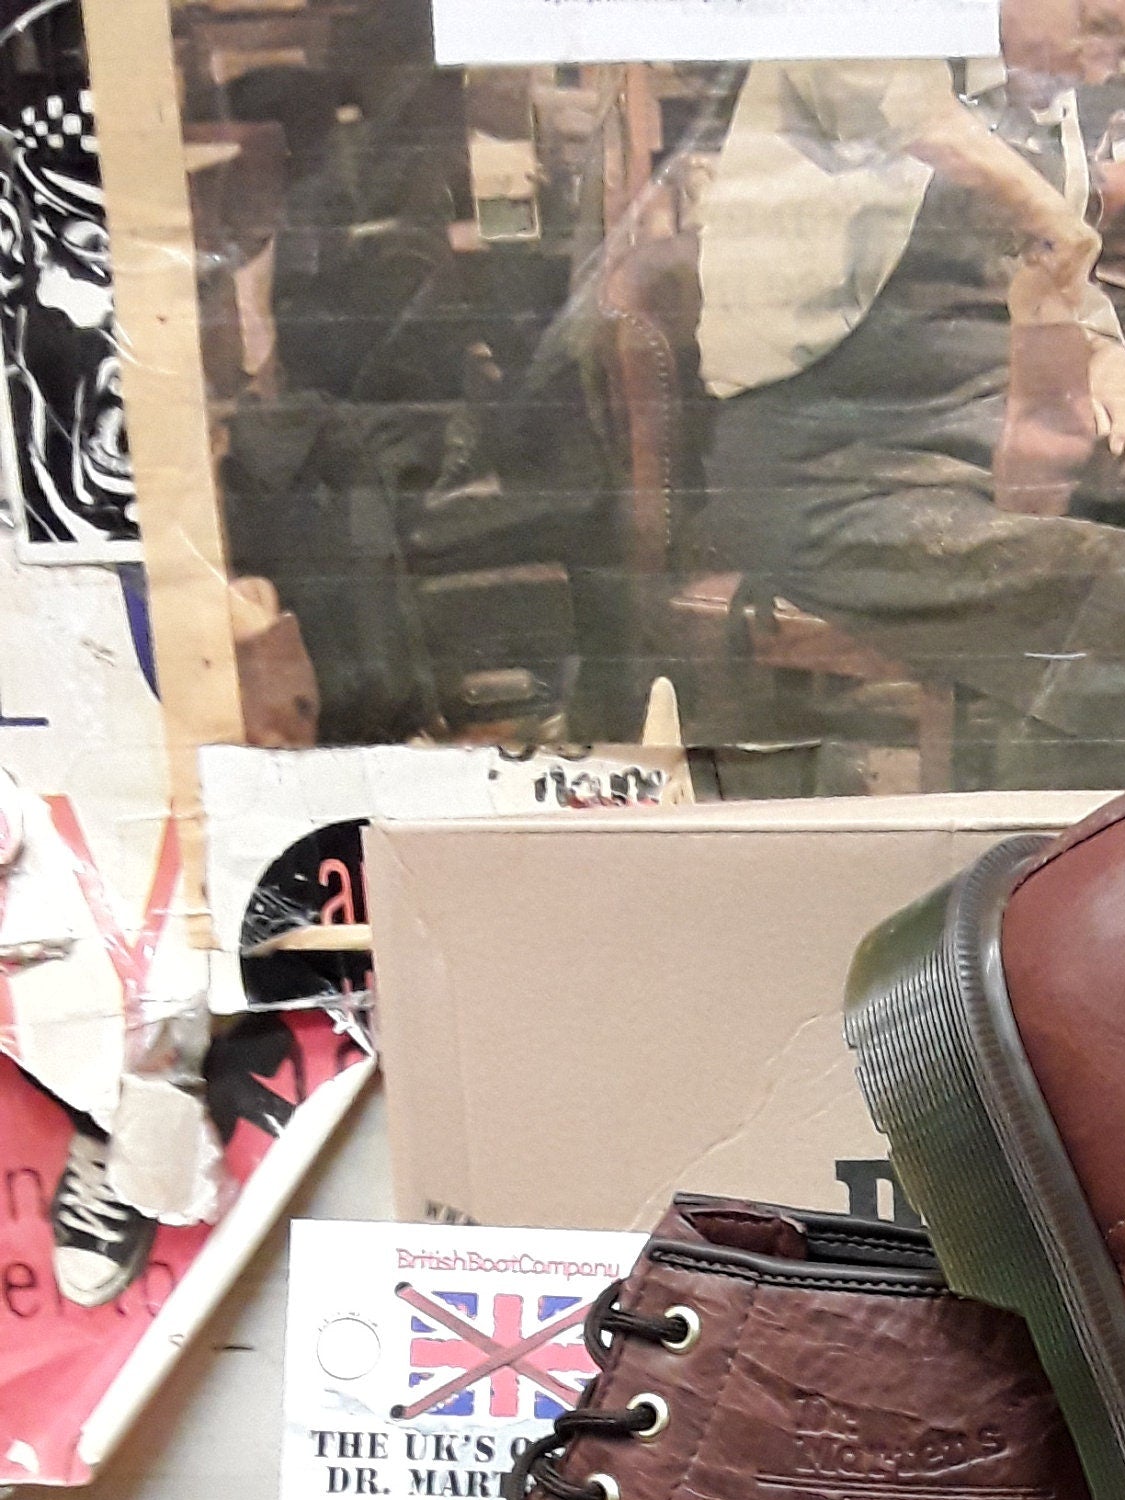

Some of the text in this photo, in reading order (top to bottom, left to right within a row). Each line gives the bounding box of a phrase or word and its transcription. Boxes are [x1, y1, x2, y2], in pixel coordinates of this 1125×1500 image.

[396, 1248, 620, 1281] BritishBootCompany
[311, 1430, 389, 1459] THE
[405, 1432, 496, 1463] UK'S
[326, 1465, 391, 1496] DR.
